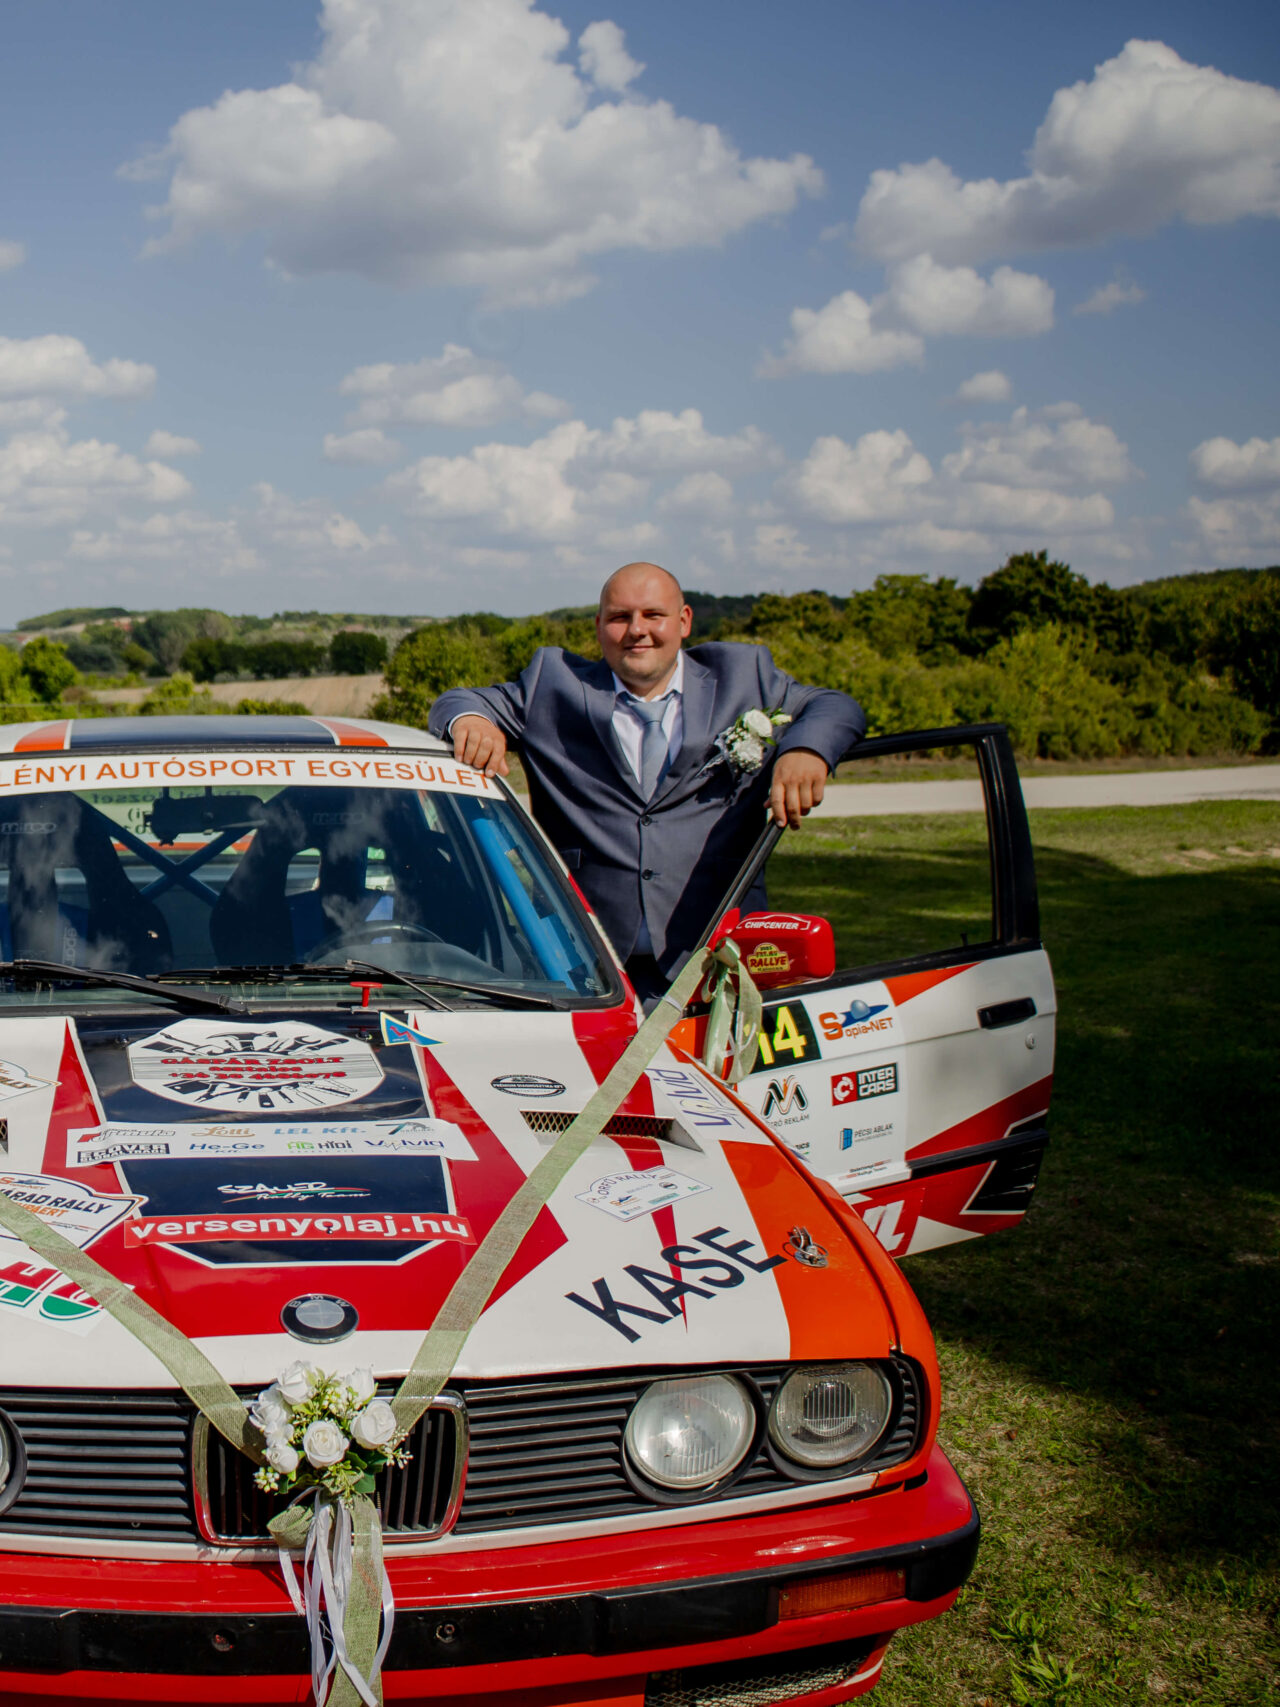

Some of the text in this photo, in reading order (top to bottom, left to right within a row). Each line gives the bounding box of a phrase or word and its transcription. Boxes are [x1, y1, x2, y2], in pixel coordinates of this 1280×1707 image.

[96, 757, 296, 780] AUTÓSPORT
[308, 760, 491, 790] EGYESÜLET
[744, 921, 800, 930] CHIPCENTER
[750, 956, 787, 968] RALLYE
[858, 1066, 894, 1085] INTER
[858, 1079, 896, 1097] CARS
[189, 1142, 265, 1150] He-Ge
[47, 1196, 113, 1214] RALLY
[256, 1191, 315, 1201] Rally
[131, 1214, 470, 1240] versenyolaj.hu
[563, 1226, 789, 1344] KASE
